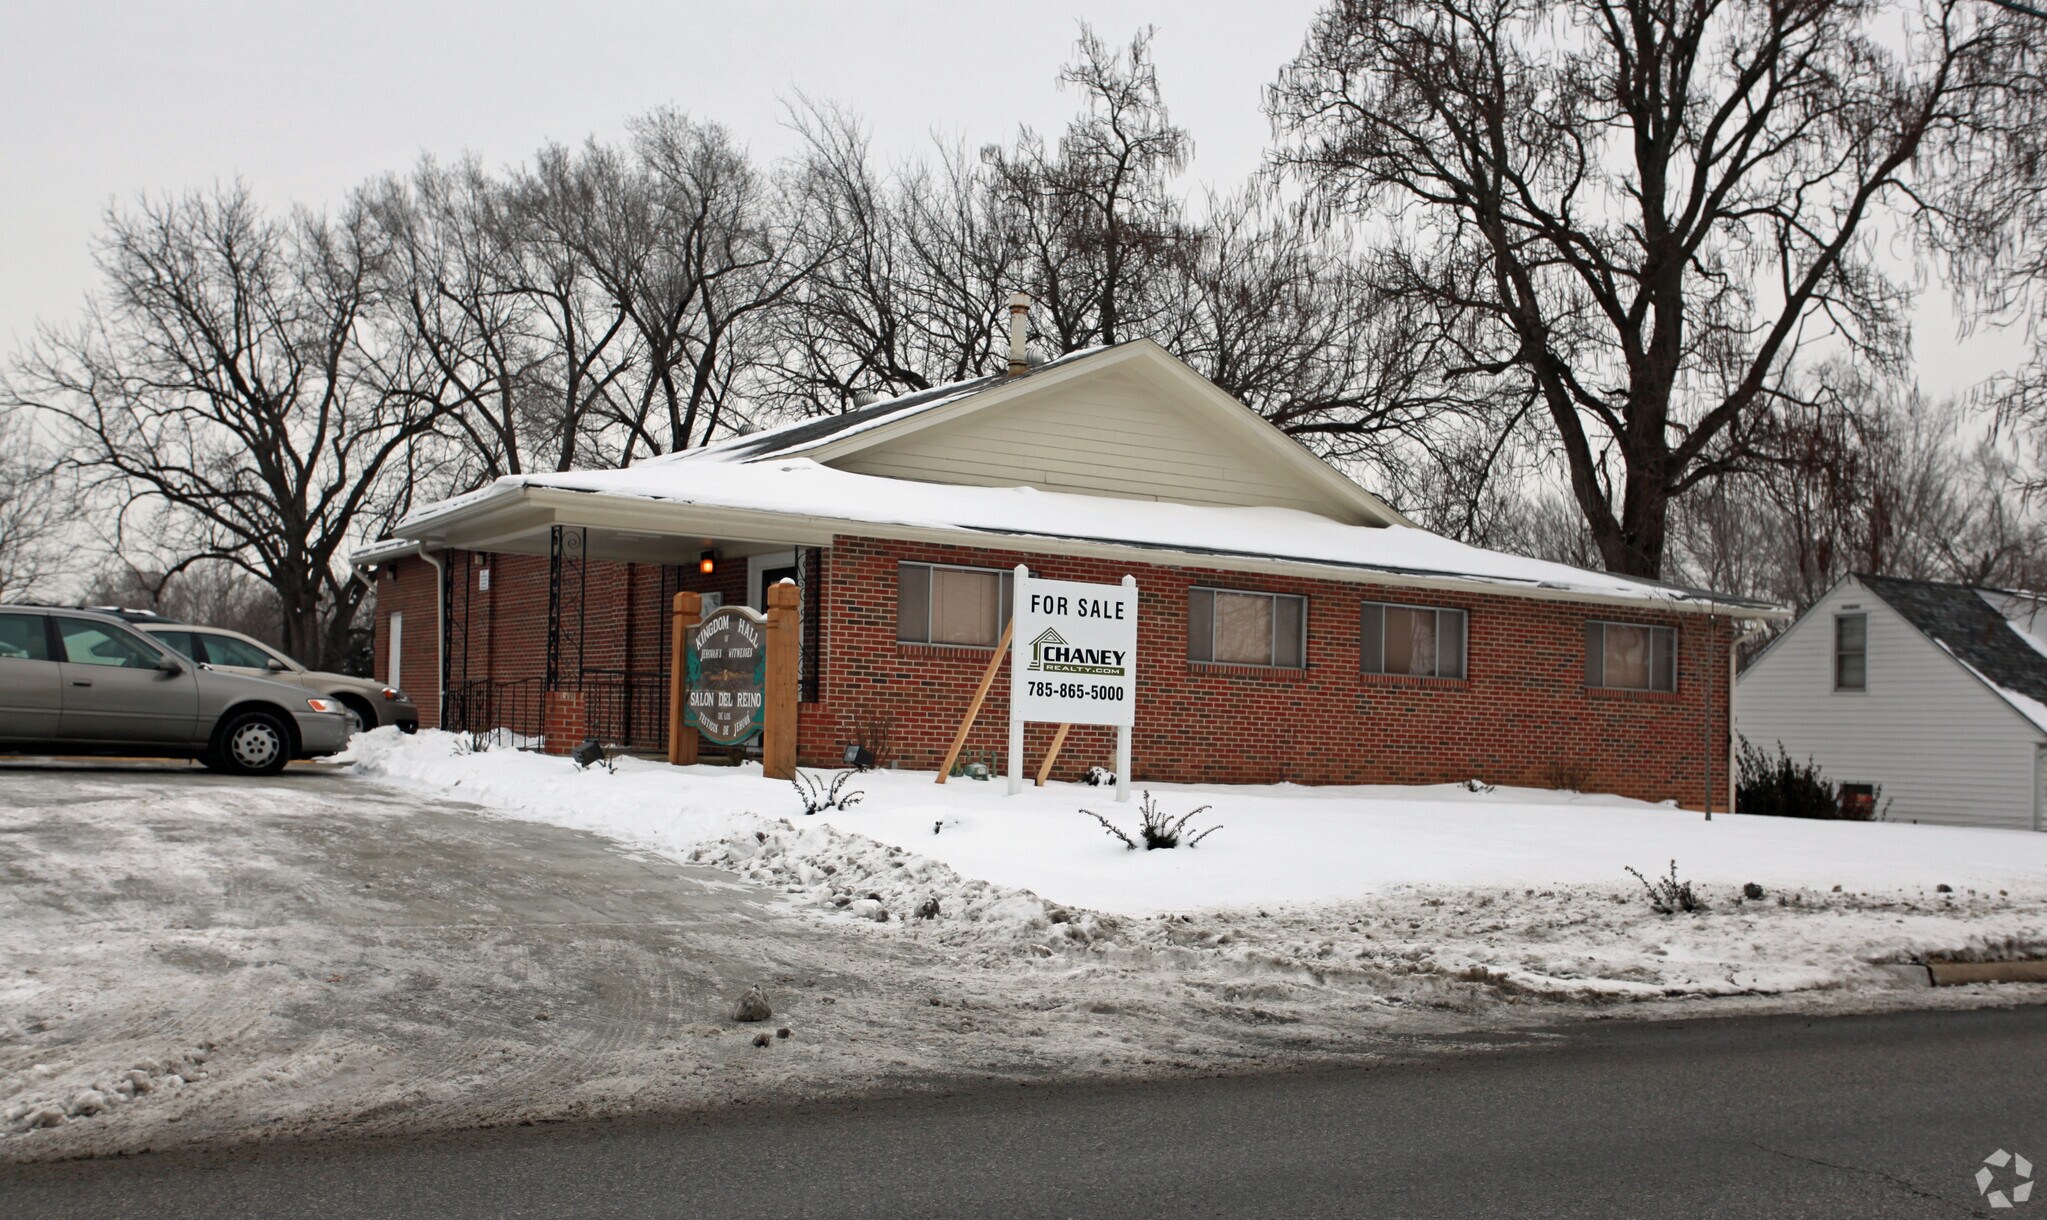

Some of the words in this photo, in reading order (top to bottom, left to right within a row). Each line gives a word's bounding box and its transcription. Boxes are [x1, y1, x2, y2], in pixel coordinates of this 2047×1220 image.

[1031, 594, 1068, 616] FOR
[1078, 598, 1124, 620] SALE
[695, 615, 730, 650] KINGDOM
[738, 618, 759, 649] HALL
[1043, 646, 1126, 666] CHANEY
[1046, 665, 1120, 675] REALTY.COM
[690, 692, 714, 707] SALON
[718, 693, 733, 707] DEL
[737, 693, 762, 708] REINO
[1028, 681, 1124, 701] 785-865-5000
[699, 711, 719, 734] TESTIGOS
[717, 712, 724, 720] DE
